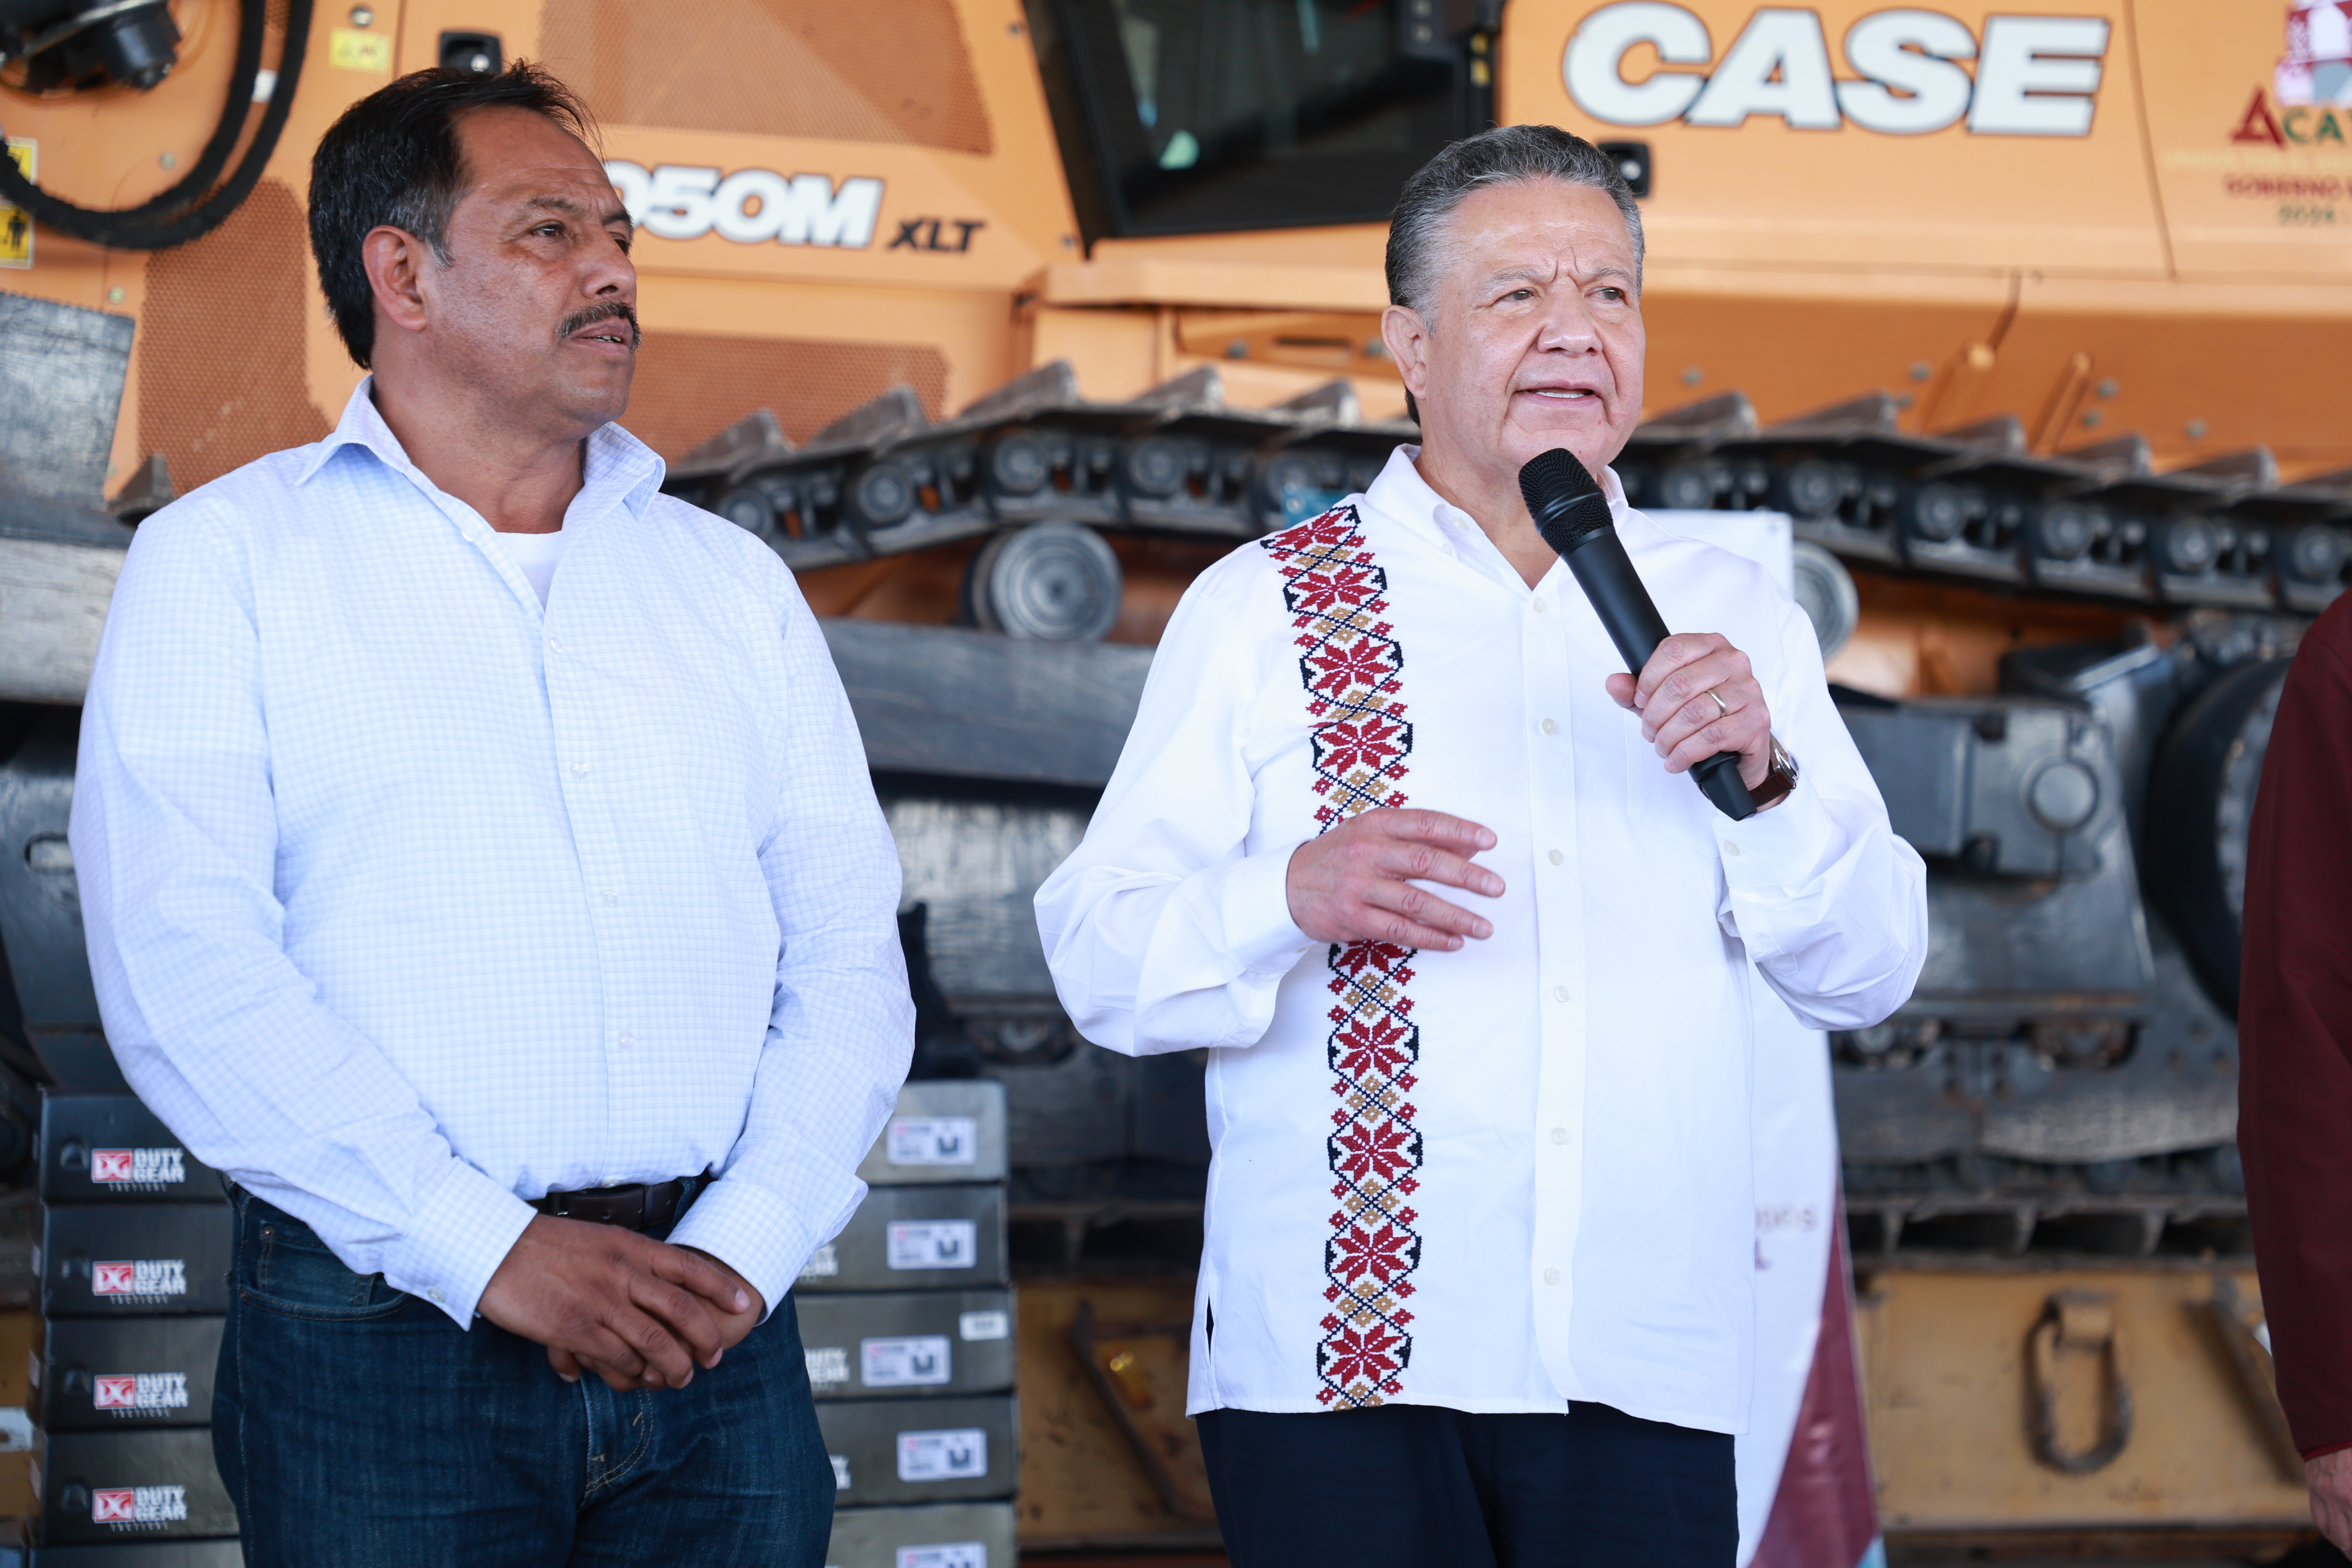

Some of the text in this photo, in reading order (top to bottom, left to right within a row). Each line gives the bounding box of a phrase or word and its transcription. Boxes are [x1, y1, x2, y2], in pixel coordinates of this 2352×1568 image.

[1563, 1, 2112, 136] CASE
[887, 216, 986, 253] XLT
[134, 1148, 183, 1168] DUTY
[134, 1167, 186, 1183] GEAR
[135, 1259, 185, 1279] DUTY
[134, 1279, 187, 1295] GEAR
[137, 1372, 187, 1393] DUTY
[136, 1392, 189, 1408] GEAR
[135, 1485, 186, 1506] DUTY
[135, 1505, 187, 1521] GEAR
